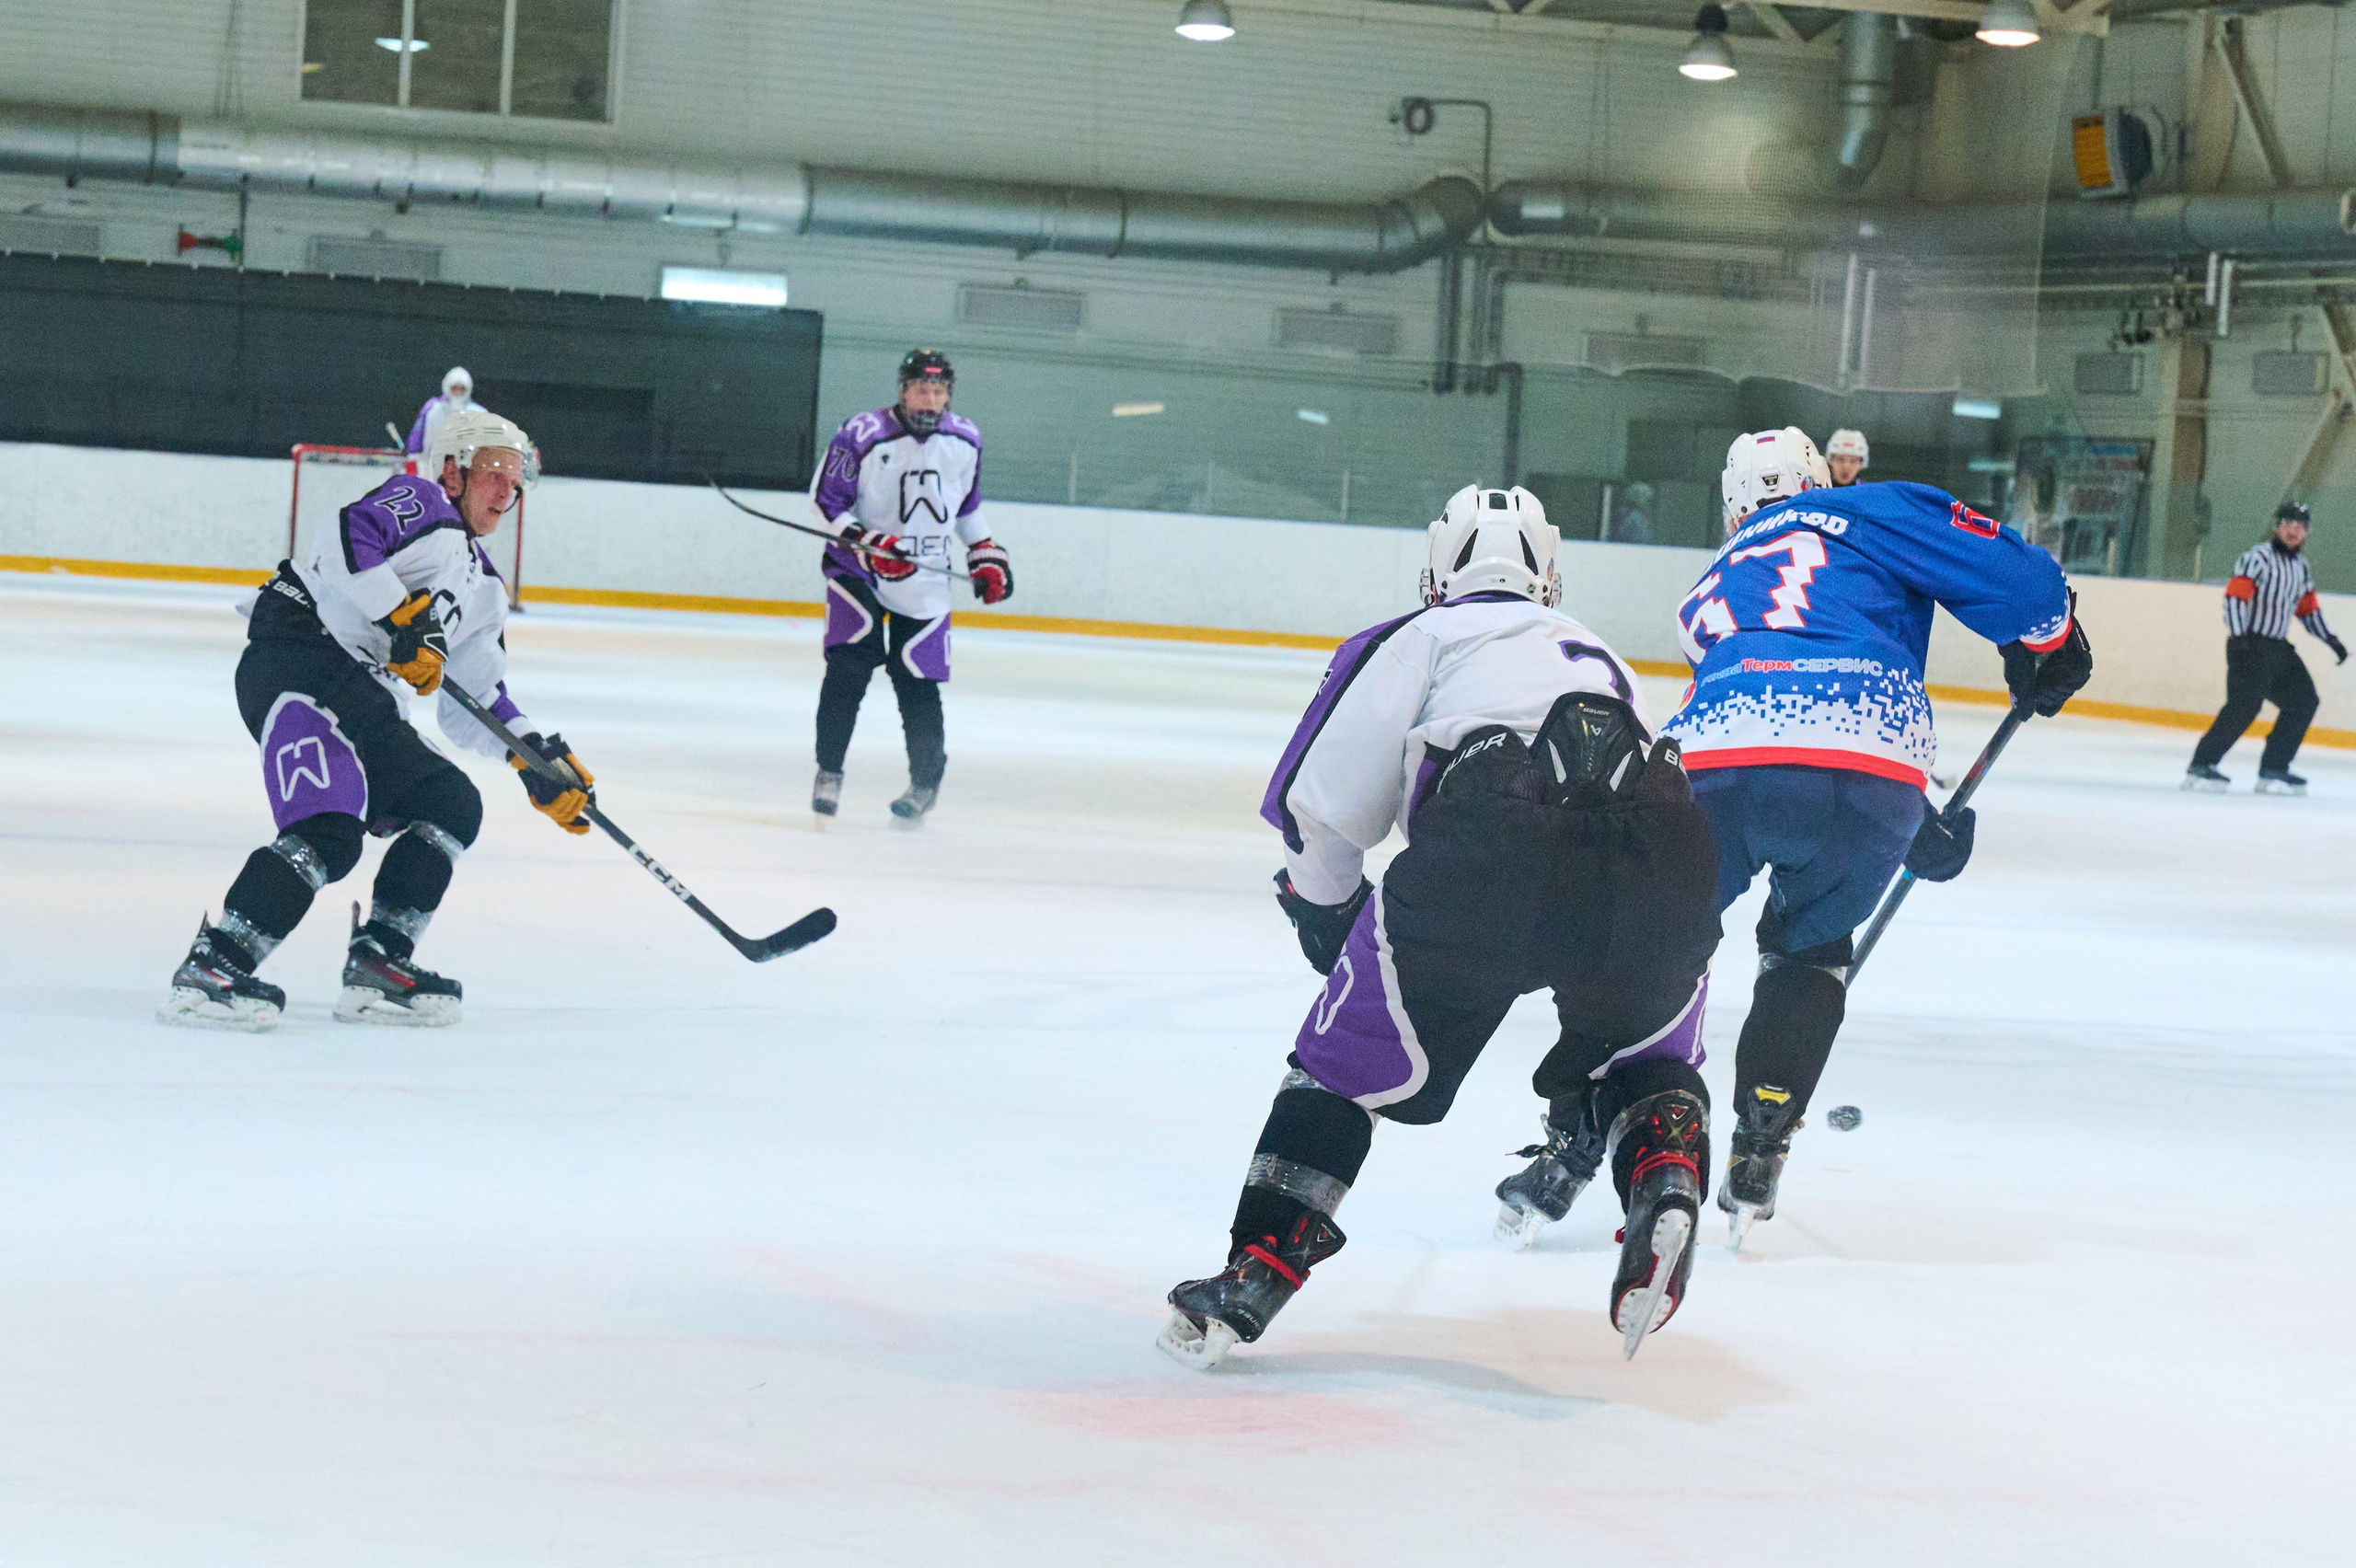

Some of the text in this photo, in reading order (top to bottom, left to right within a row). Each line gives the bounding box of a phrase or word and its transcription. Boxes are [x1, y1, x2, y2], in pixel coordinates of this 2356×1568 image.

[374, 485, 425, 536] 22
[272, 580, 310, 608] BAU
[628, 842, 691, 902] CCM
